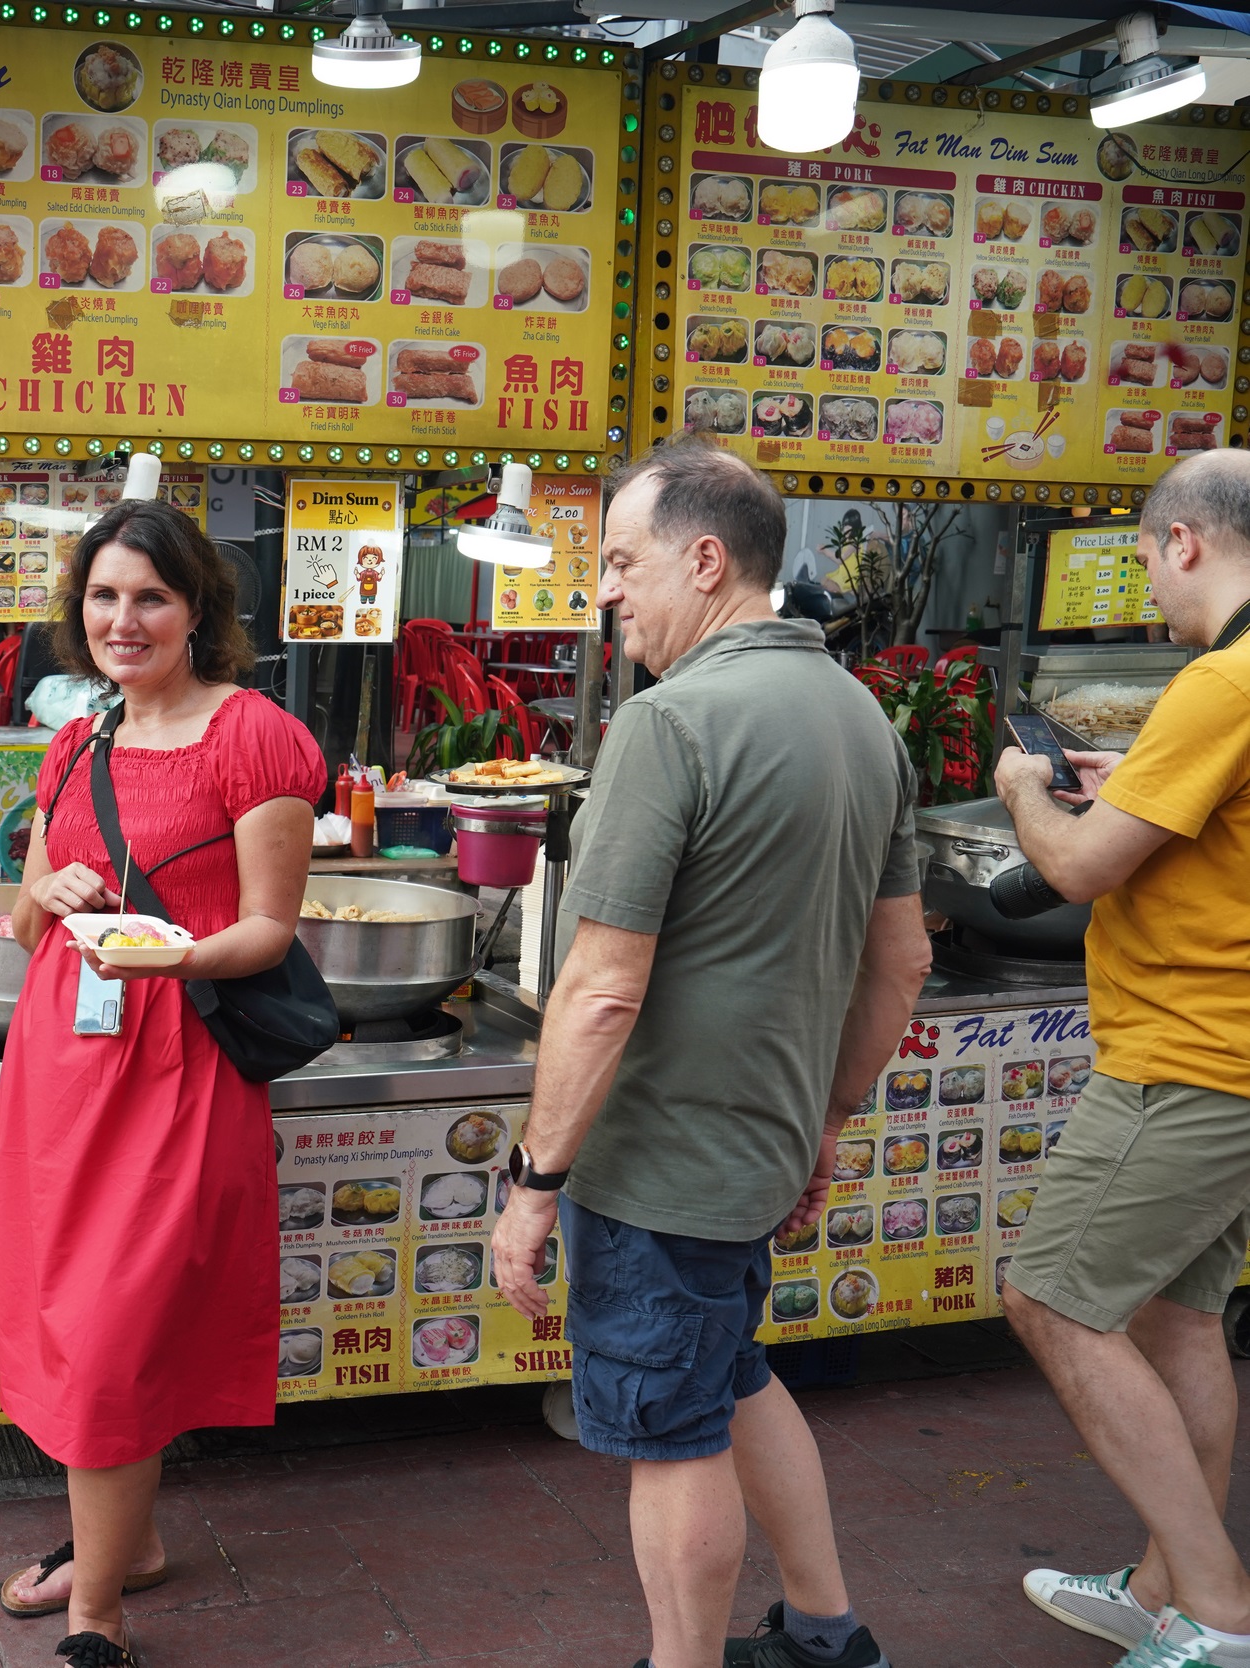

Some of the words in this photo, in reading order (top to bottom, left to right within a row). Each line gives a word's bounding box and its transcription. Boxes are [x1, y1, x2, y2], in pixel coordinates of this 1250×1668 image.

[161, 56, 300, 92] 乾隆燒賣皇
[160, 88, 210, 112] Dynasty
[213, 93, 242, 110] Qian
[245, 94, 275, 114] Long
[278, 96, 344, 118] Dumplings
[894, 130, 928, 158] Fat
[936, 133, 982, 159] Man
[990, 138, 1030, 160] Dim
[1036, 142, 1078, 166] Sum
[788, 161, 822, 179] 豬肉
[834, 165, 872, 182] PORK
[292, 186, 302, 194] 23
[1030, 182, 1086, 198] CHICKEN
[1152, 188, 1182, 206] 魚肉
[1188, 192, 1216, 207] FISH
[314, 214, 326, 224] Fish
[328, 216, 354, 227] Dumpling
[396, 292, 406, 301] 27
[415, 326, 431, 335] Fried
[433, 327, 444, 336] Fish
[446, 328, 460, 337] Cake
[31, 332, 134, 376] 雞肉
[503, 354, 583, 396] 魚肉
[498, 398, 589, 431] FISH
[12, 462, 35, 471] Fat
[38, 462, 66, 471] Man
[312, 492, 342, 505] Dim
[346, 492, 379, 506] Sum
[544, 484, 565, 495] Dim
[569, 485, 592, 496] Sum
[328, 510, 358, 525] 點心
[526, 508, 537, 517] PC
[552, 507, 578, 519] 2.00
[297, 536, 326, 551] RM
[332, 536, 342, 551] 2
[1074, 537, 1096, 547] Price
[1099, 536, 1115, 545] List
[294, 589, 299, 598] 1
[303, 589, 335, 601] piece
[953, 1016, 1014, 1056] Fat
[1028, 1008, 1089, 1042] Ma
[295, 1130, 396, 1149] 康熙蝦餃皇
[294, 1155, 326, 1166] Dynasty
[328, 1154, 349, 1166] Kang
[351, 1152, 358, 1162] Xi
[360, 1150, 388, 1162] Shrimp
[390, 1148, 433, 1160] Dumplings
[934, 1264, 974, 1290] 豬肉
[933, 1292, 976, 1314] PORK
[335, 1312, 358, 1321] Golden
[827, 1324, 850, 1337] Dynasty
[851, 1322, 864, 1334] Qian
[865, 1320, 879, 1332] Long
[880, 1317, 910, 1329] Dumplings
[332, 1326, 392, 1356] 魚肉
[514, 1349, 572, 1372] SHRI
[335, 1363, 390, 1386] FISH
